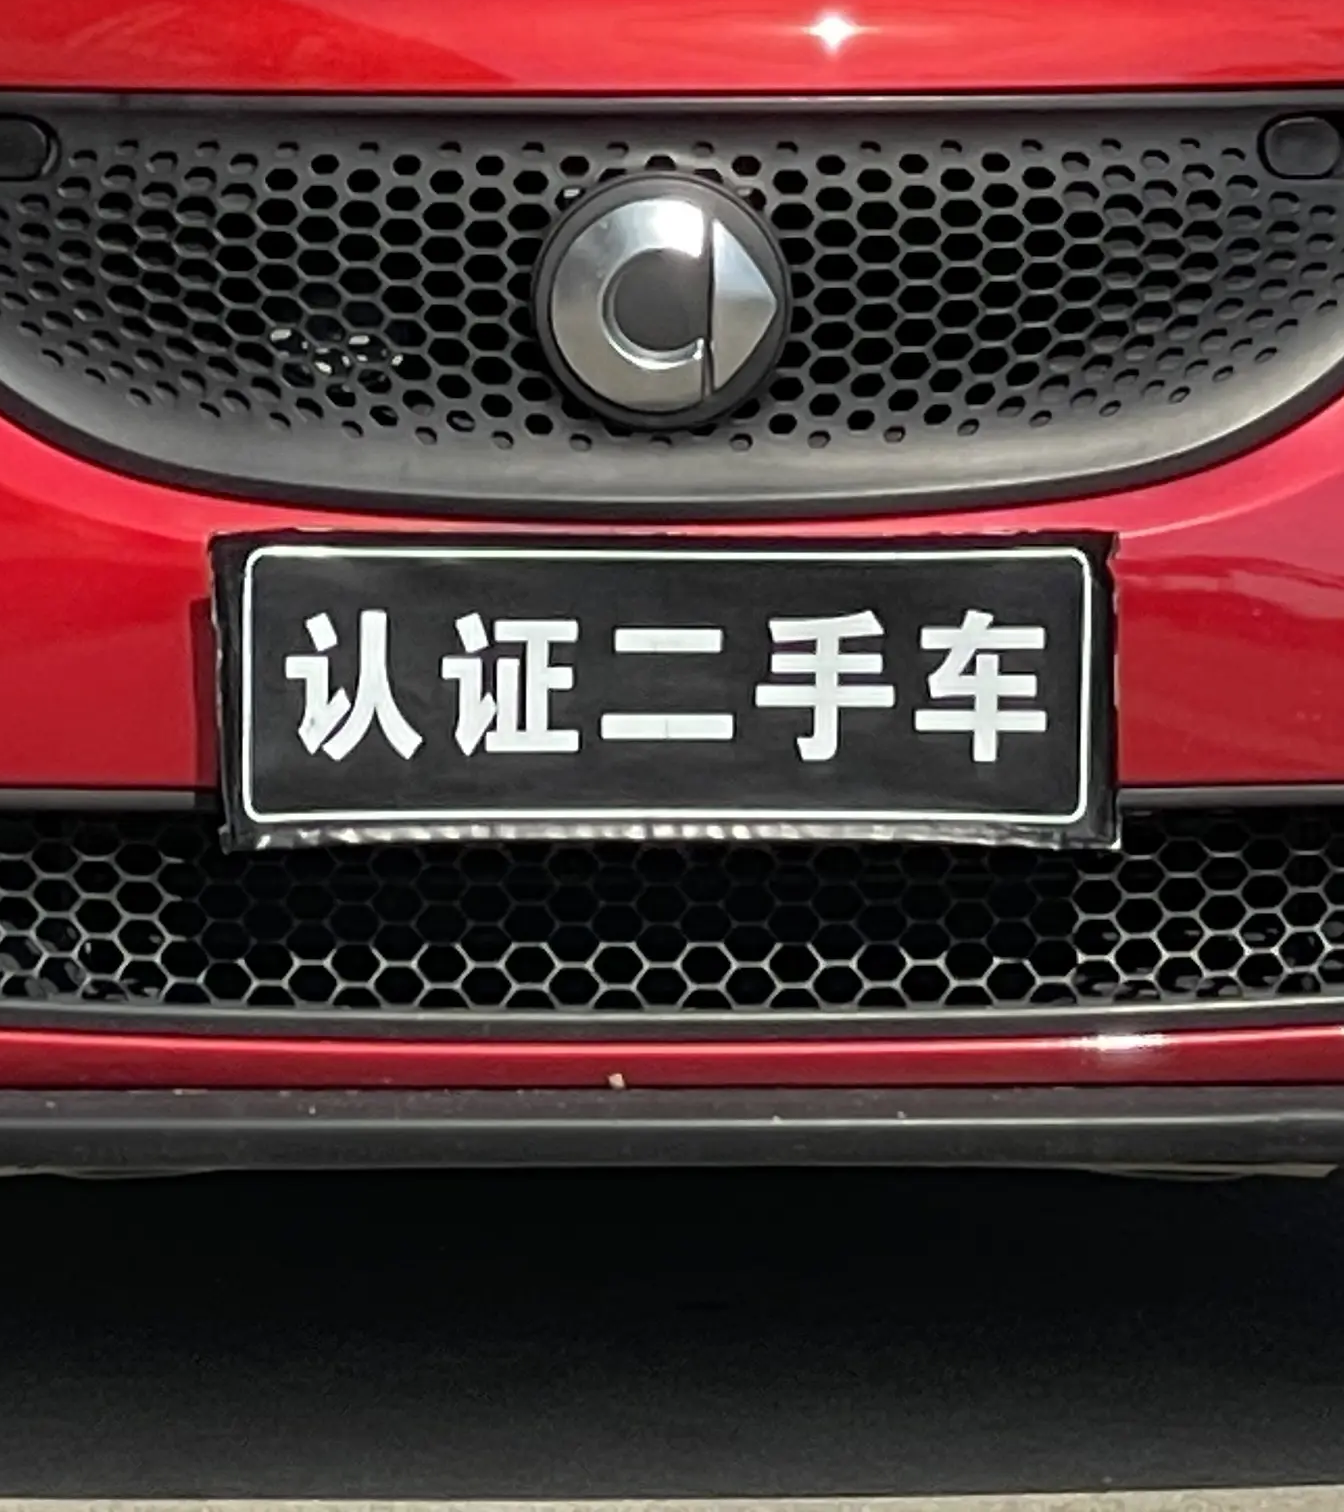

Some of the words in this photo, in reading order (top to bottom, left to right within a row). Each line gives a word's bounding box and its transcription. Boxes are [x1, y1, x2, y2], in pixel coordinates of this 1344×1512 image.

[284, 609, 1048, 763] 认证二手车
